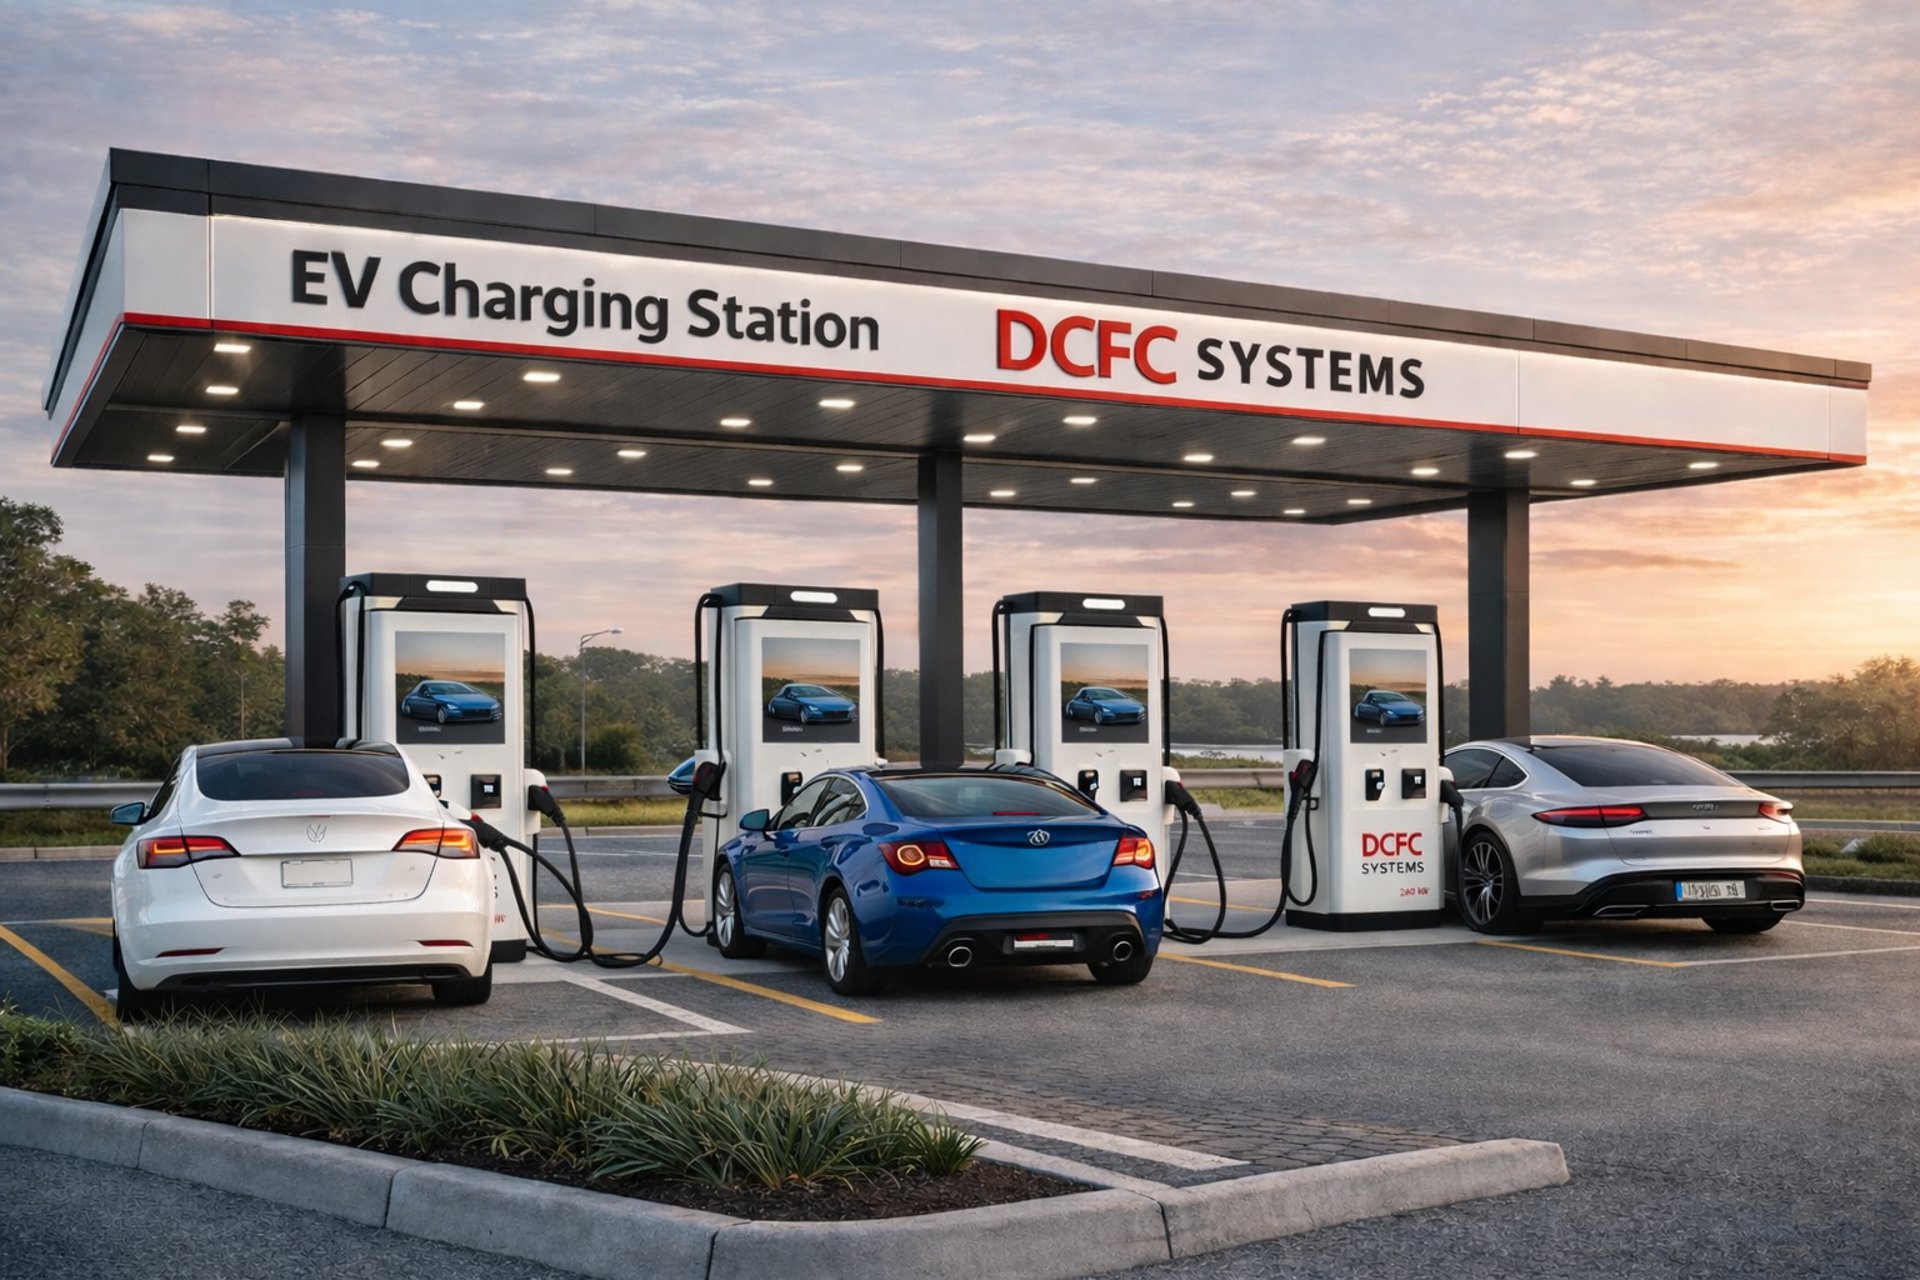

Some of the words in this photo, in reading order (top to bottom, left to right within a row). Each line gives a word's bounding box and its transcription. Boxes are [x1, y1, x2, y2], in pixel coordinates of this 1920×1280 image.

[291, 249, 382, 309] EV
[398, 260, 669, 345] Charging
[687, 288, 880, 351] Station
[996, 307, 1179, 385] DCFC
[1197, 338, 1426, 399] SYSTEMS
[1361, 832, 1423, 857] DCFC
[1361, 861, 1425, 875] SYSTEMS
